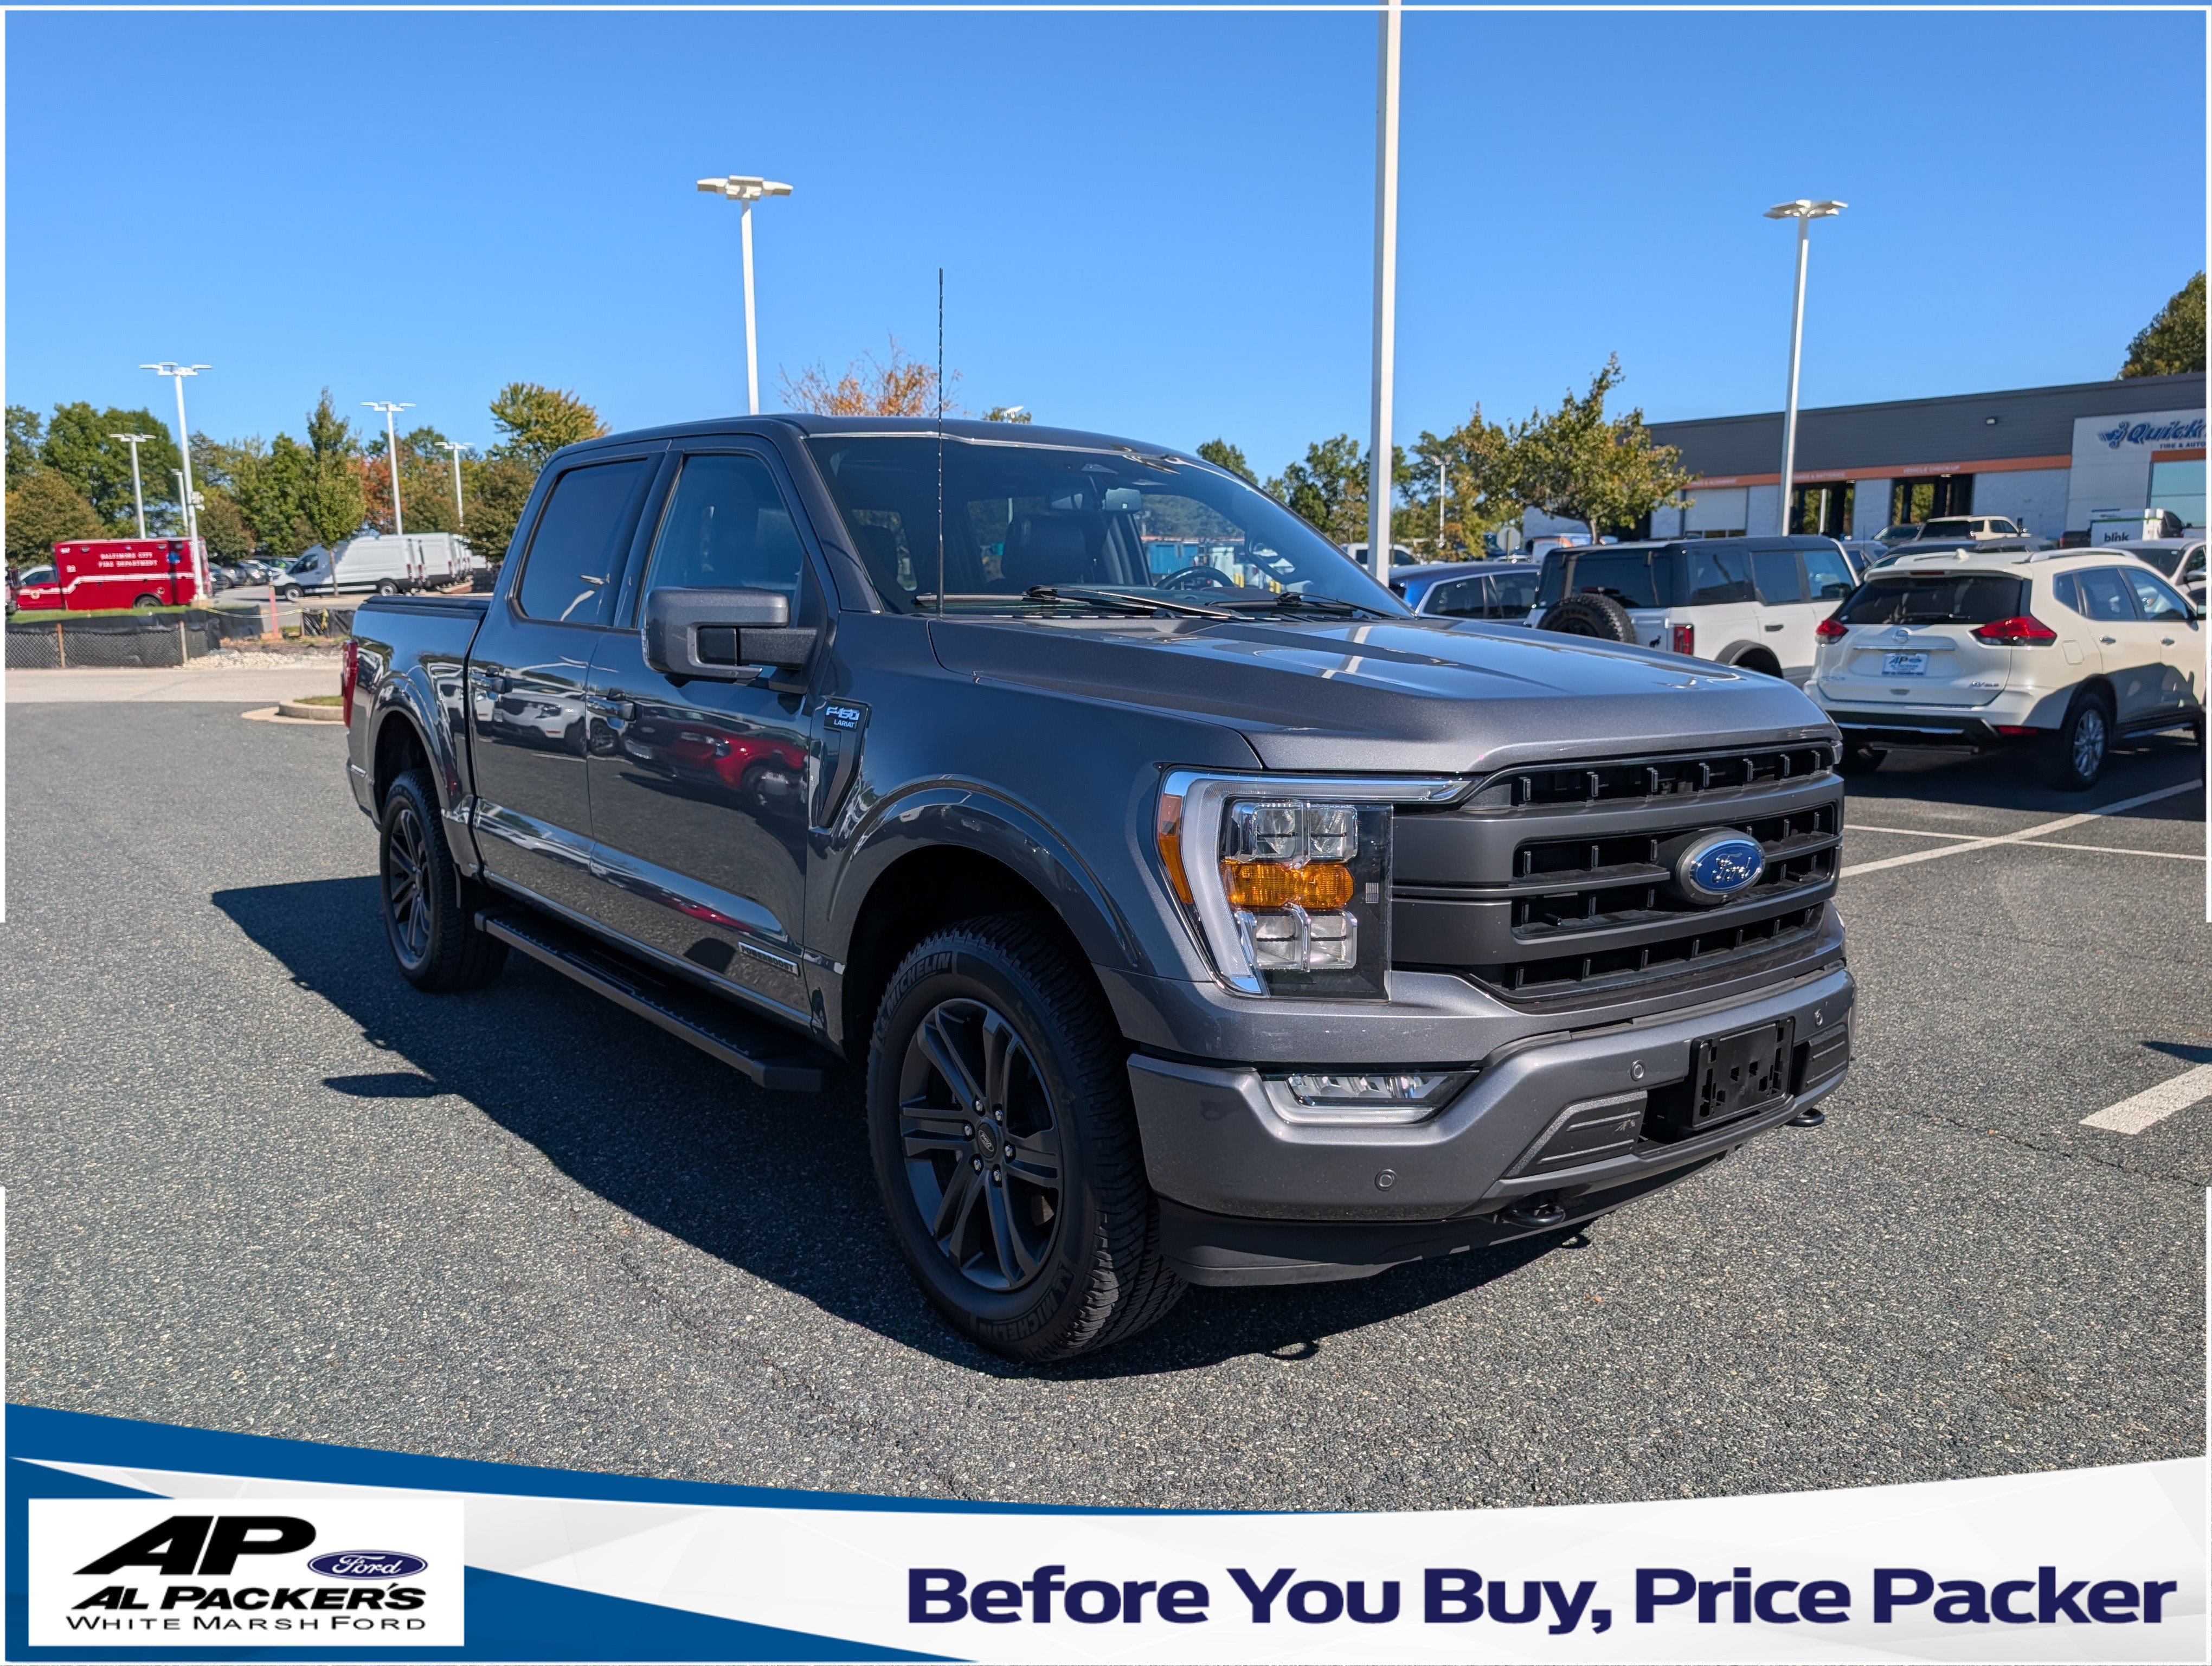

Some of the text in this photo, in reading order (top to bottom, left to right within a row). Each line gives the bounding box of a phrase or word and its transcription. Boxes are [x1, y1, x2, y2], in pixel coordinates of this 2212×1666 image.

[2127, 419, 2205, 444] Quick
[2104, 531, 2130, 542] blink
[826, 707, 860, 721] F-150
[834, 719, 855, 728] LARIAT
[1711, 852, 1751, 885] Ford
[886, 953, 951, 1016] MICHELIN
